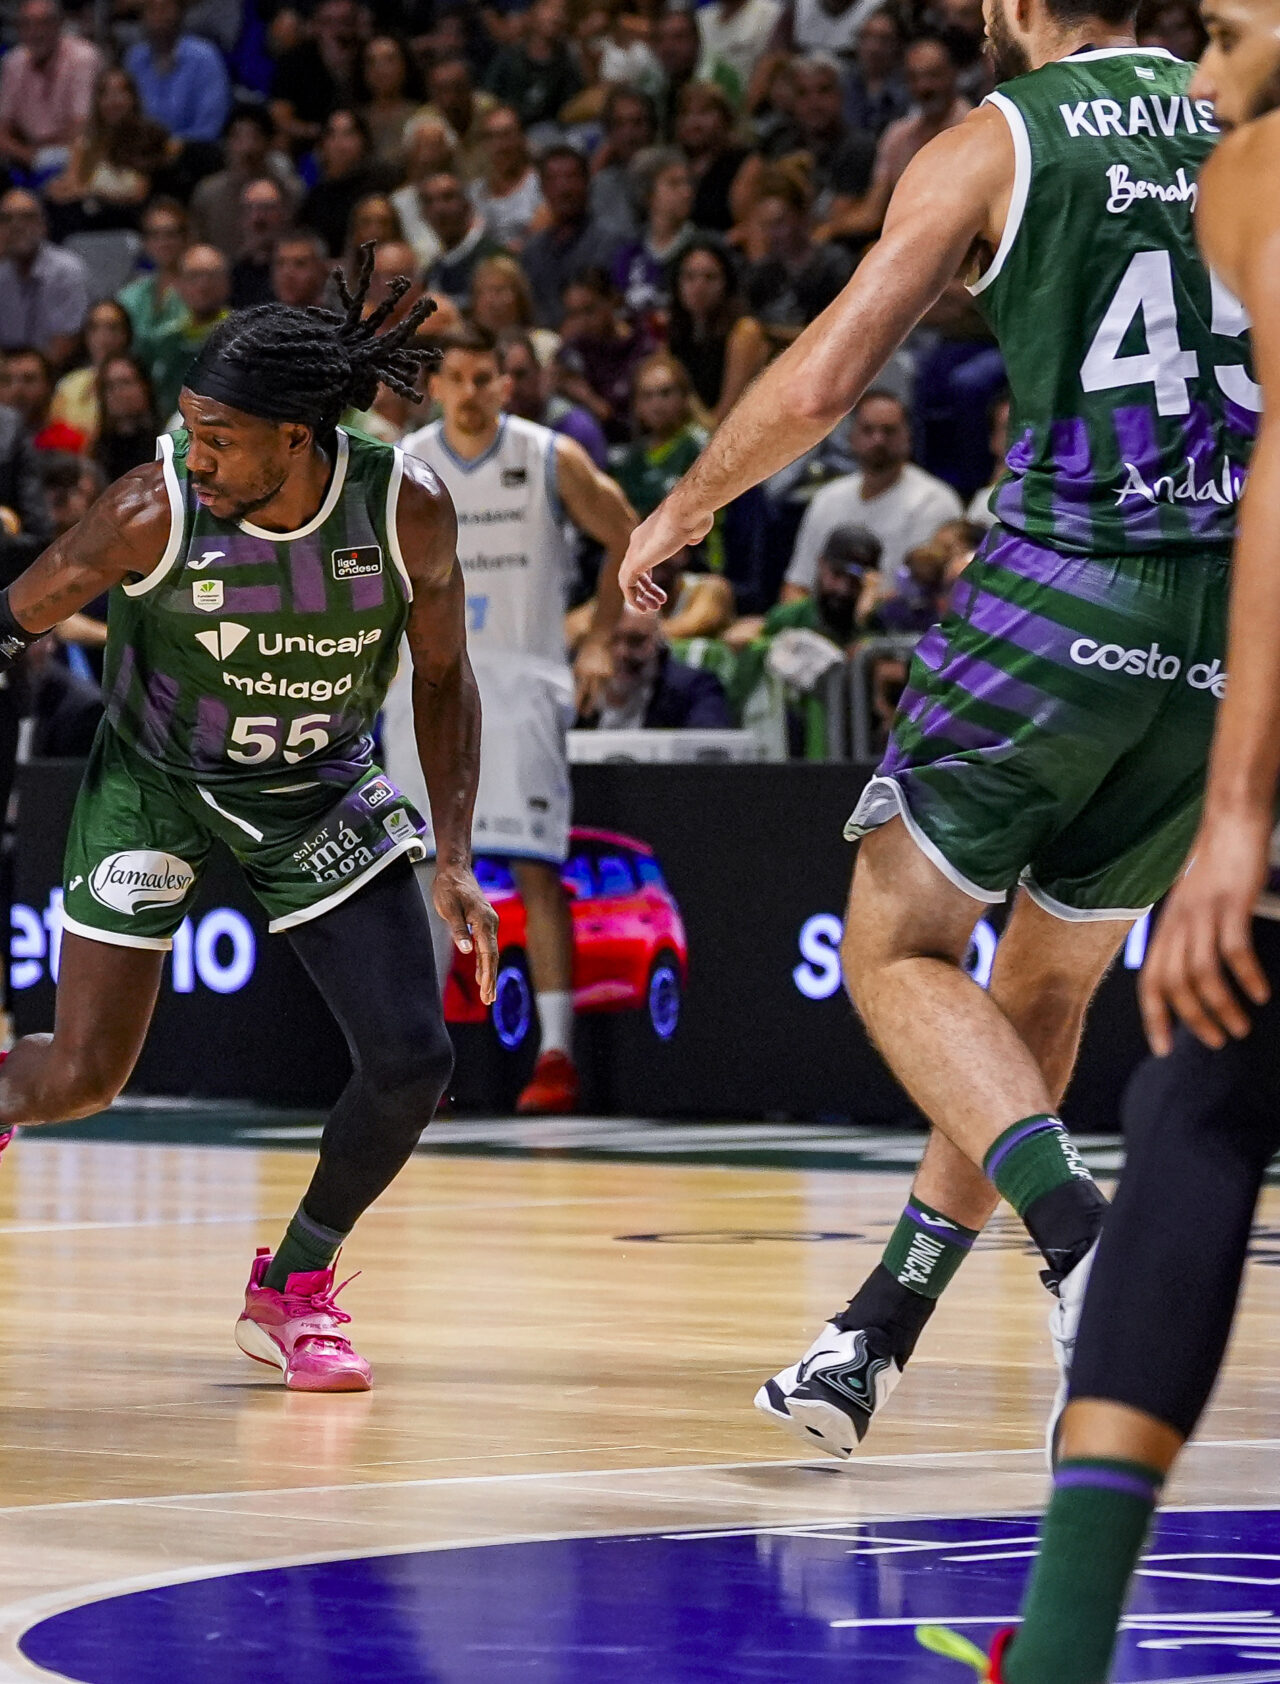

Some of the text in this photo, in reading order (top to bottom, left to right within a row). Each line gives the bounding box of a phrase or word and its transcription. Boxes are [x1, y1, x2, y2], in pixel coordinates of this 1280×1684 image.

[1059, 94, 1220, 138] KRAVIS
[1105, 164, 1199, 213] Benah
[337, 558, 357, 569] liga
[338, 564, 379, 576] endesa
[257, 628, 382, 657] Unicaja
[1070, 638, 1181, 680] costa
[222, 671, 352, 701] málaga
[226, 713, 331, 765] 55
[368, 788, 387, 805] acb
[292, 827, 329, 862] sabor
[299, 860, 311, 872] a
